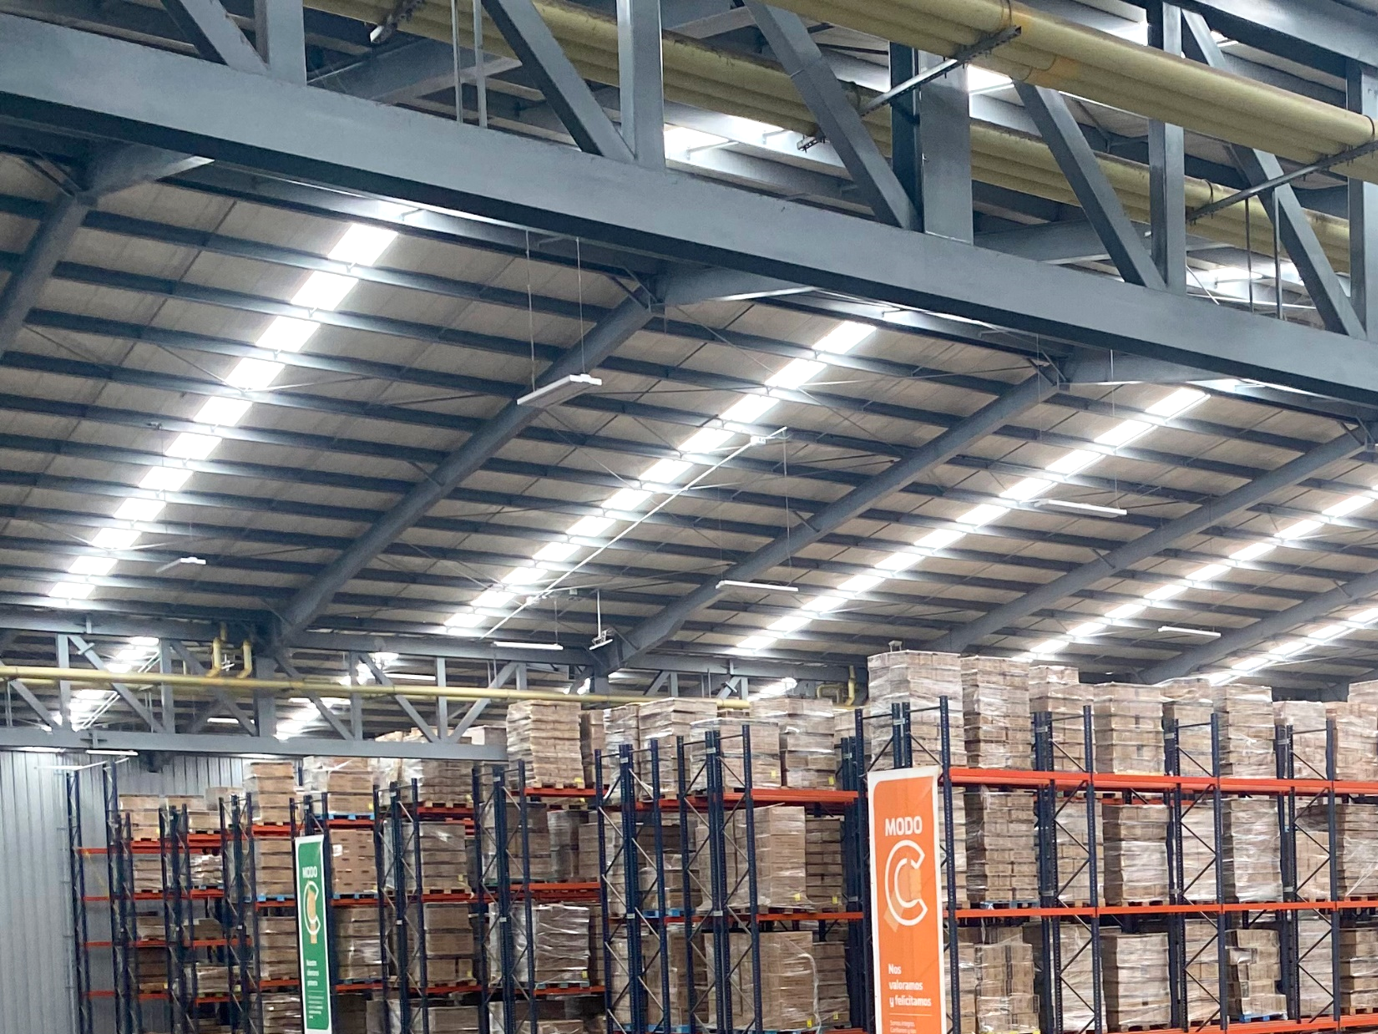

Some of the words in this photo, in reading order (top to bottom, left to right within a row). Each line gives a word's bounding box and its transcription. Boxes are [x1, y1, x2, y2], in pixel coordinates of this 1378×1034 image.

[885, 815, 922, 836] MODO
[888, 963, 902, 975] Nos
[889, 979, 923, 991] valoramos
[895, 994, 932, 1007] felicitamos
